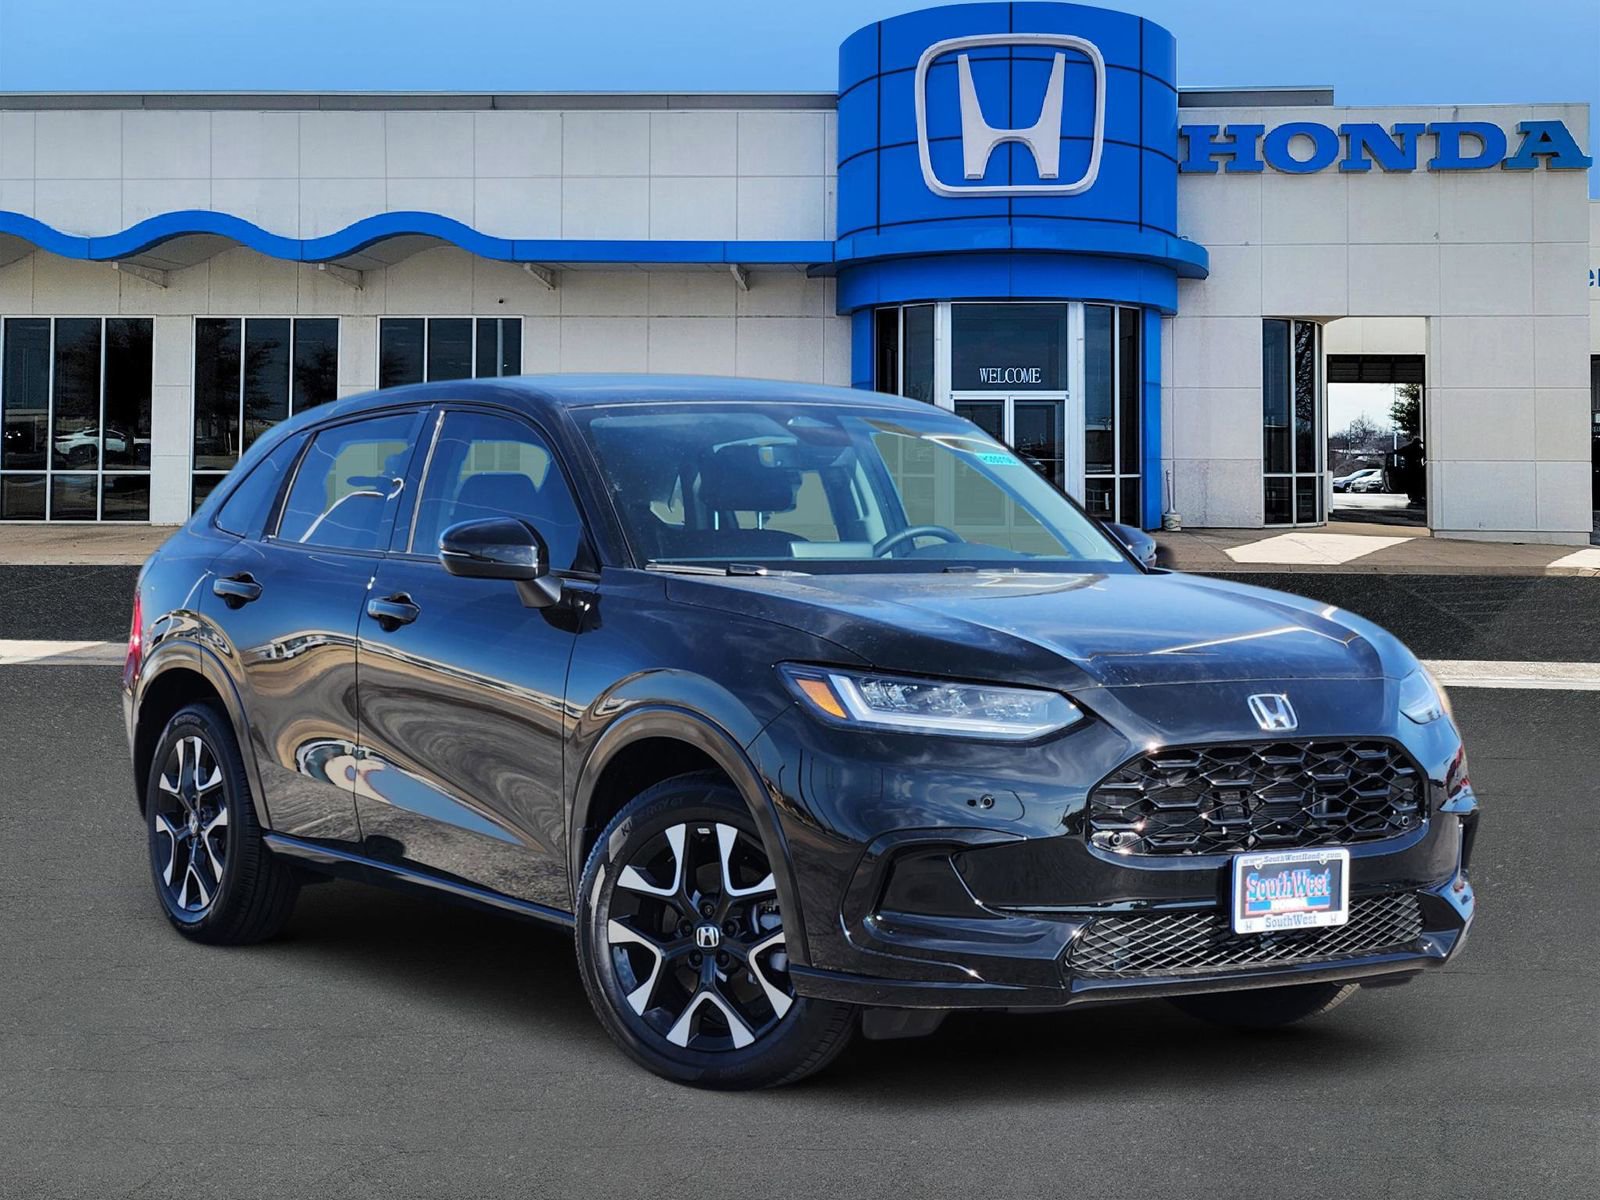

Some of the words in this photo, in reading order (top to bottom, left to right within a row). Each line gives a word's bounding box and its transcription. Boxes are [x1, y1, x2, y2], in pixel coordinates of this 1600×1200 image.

[1178, 120, 1593, 174] HONDA
[979, 367, 1042, 384] WELCOME
[1246, 869, 1330, 901] SouthWest
[1266, 915, 1317, 928] SouthWest
